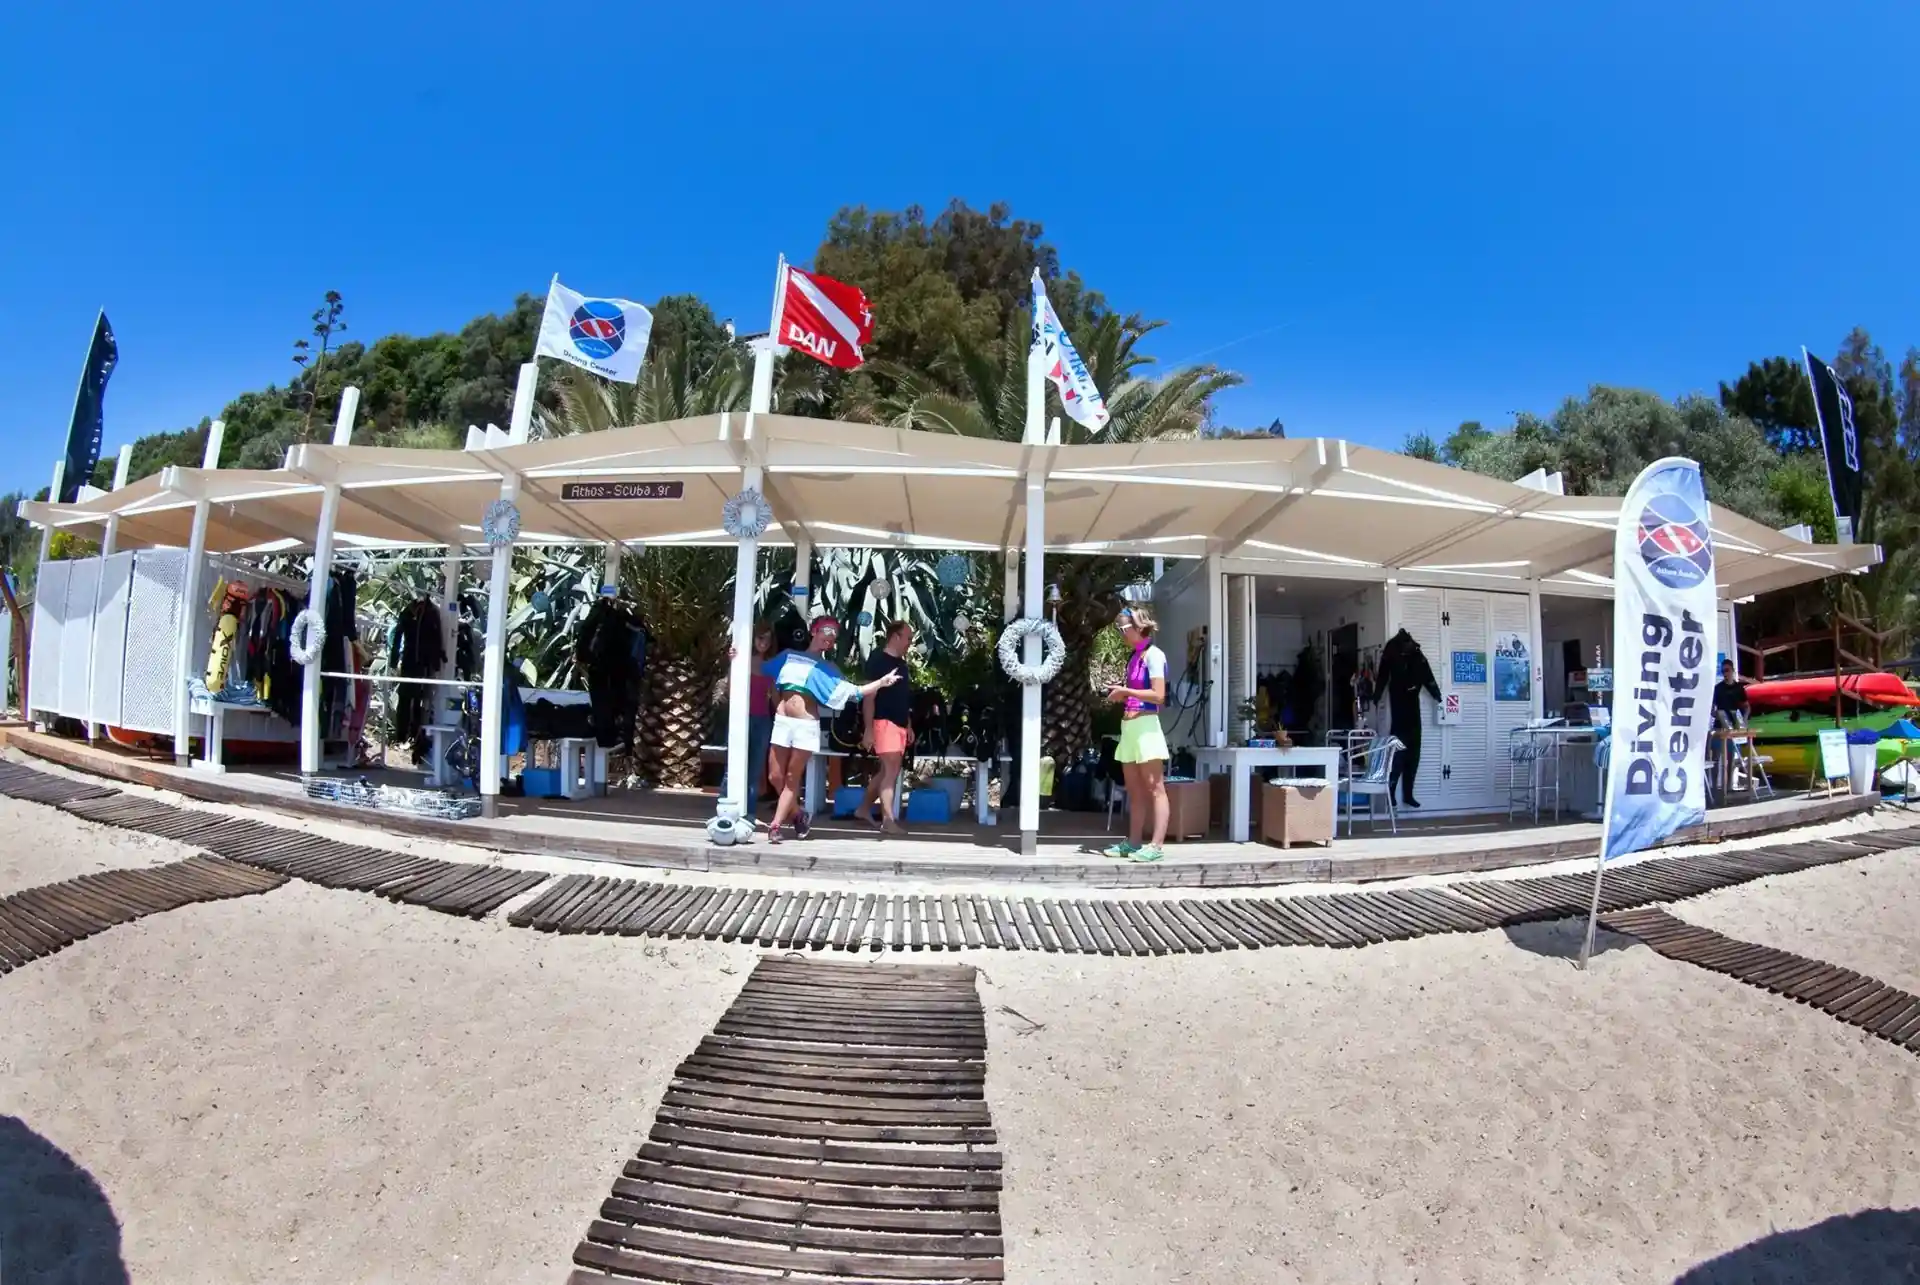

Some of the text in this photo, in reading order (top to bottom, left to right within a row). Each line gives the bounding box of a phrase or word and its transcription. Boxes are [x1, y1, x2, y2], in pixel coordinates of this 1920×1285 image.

[788, 323, 838, 358] DAN
[563, 348, 588, 366] Diving
[590, 360, 618, 376] Center
[1456, 653, 1477, 662] DIVE
[1456, 663, 1485, 672] CENTER
[1625, 613, 1673, 795] Diving
[1658, 609, 1704, 803] Center
